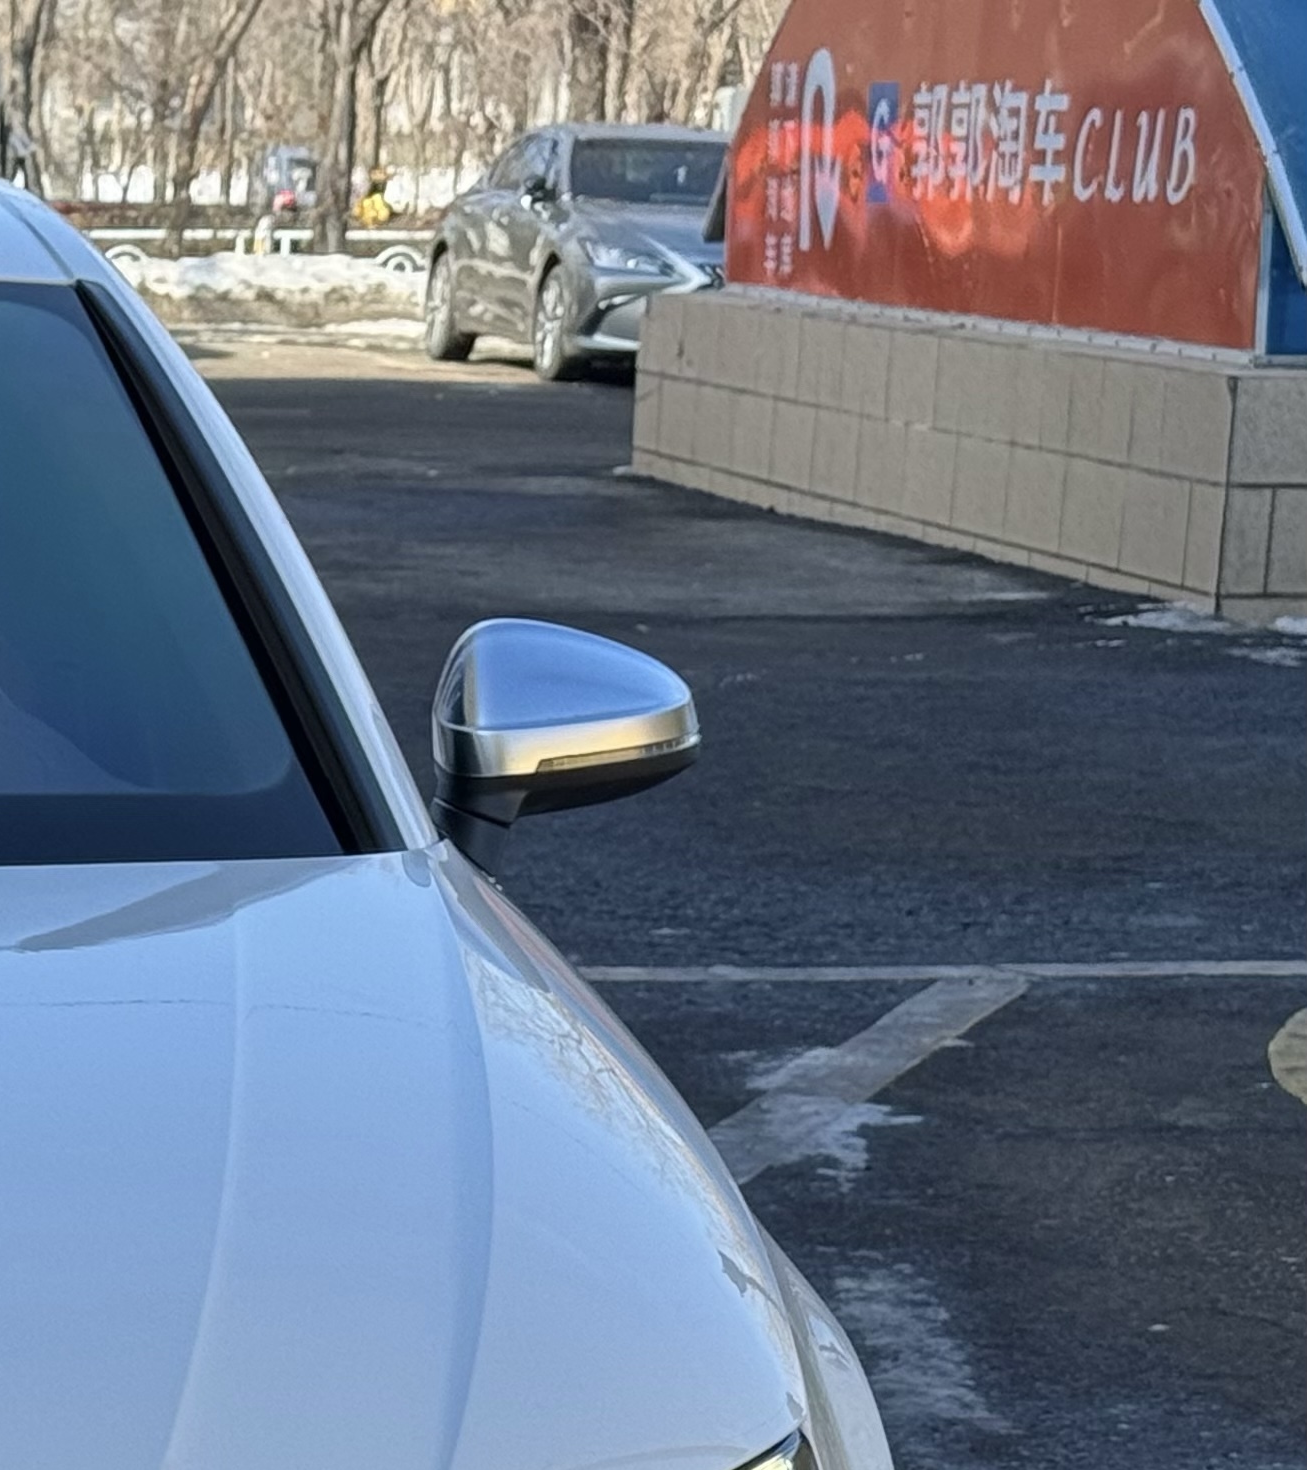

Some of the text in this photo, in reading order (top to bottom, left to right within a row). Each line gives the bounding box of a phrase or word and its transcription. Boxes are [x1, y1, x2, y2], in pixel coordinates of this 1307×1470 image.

[911, 79, 1069, 205] 郭郭淘车
[1073, 106, 1196, 205] CLUB
